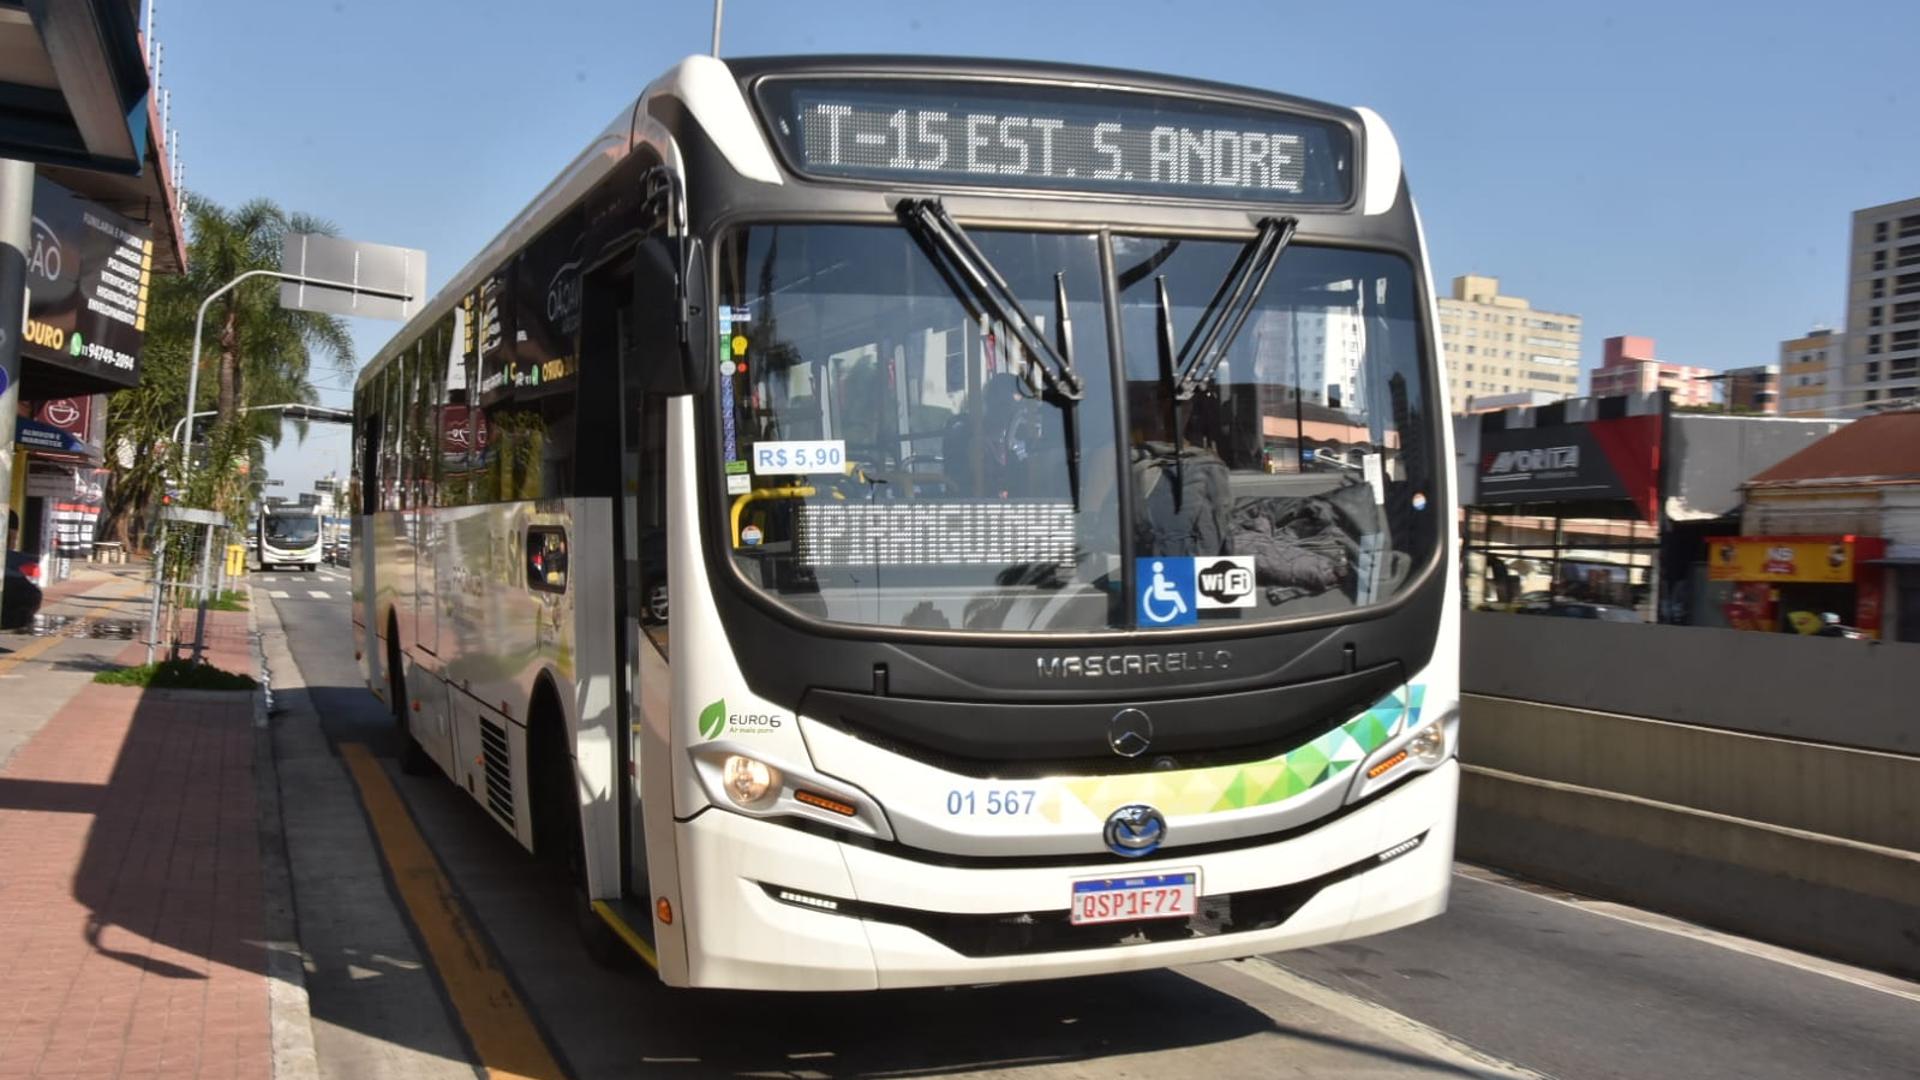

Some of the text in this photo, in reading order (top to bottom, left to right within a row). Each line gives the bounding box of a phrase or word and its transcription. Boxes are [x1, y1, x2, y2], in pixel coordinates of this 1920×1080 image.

[817, 104, 1301, 193] T-15 EST. S. ANDRE
[27, 232, 61, 281] ÃO
[759, 448, 840, 468] R$ 5,90
[804, 503, 1076, 566] IPIRANGUINHA
[1036, 650, 1231, 678] MASCARELLO
[946, 790, 1036, 816] 01 567
[1083, 888, 1182, 918] QSP1F72
